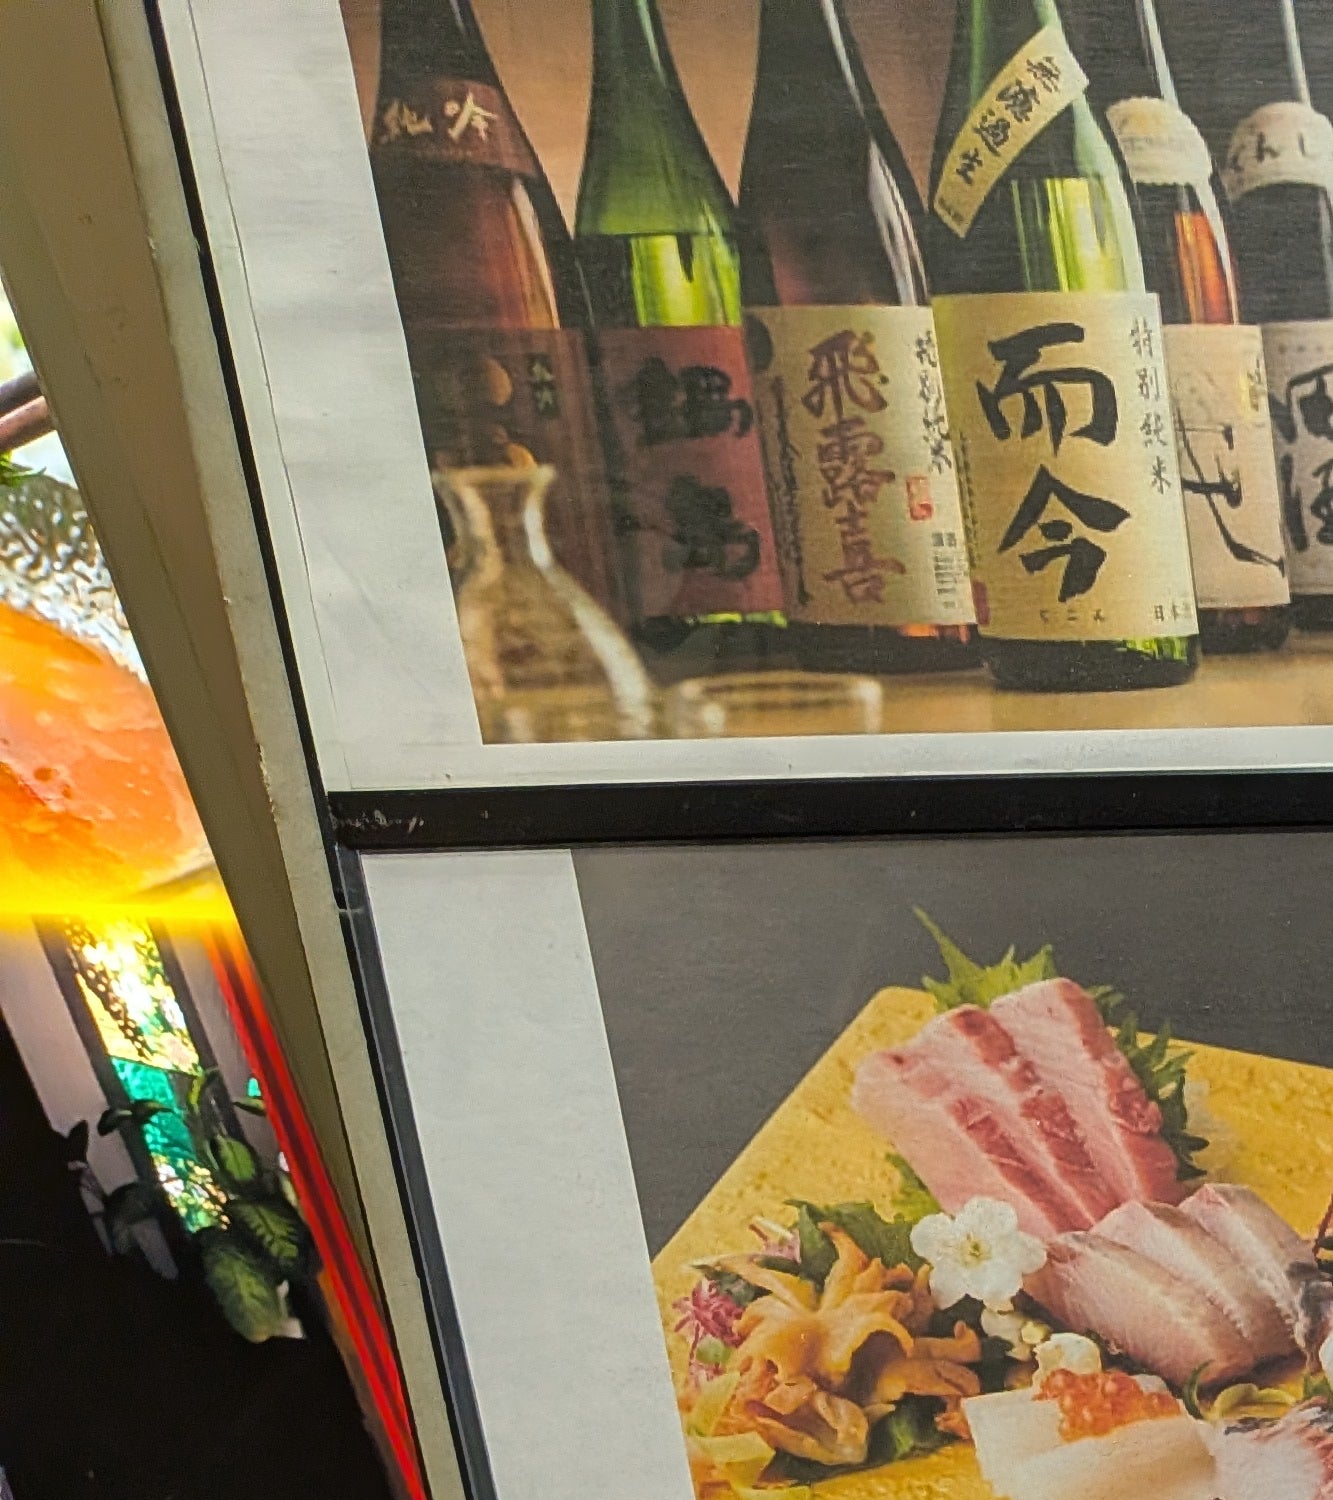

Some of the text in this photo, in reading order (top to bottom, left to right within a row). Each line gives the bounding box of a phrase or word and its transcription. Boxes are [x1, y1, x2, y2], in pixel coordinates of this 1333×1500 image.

[800, 329, 906, 603] 飛露喜
[976, 322, 1130, 602] 而今
